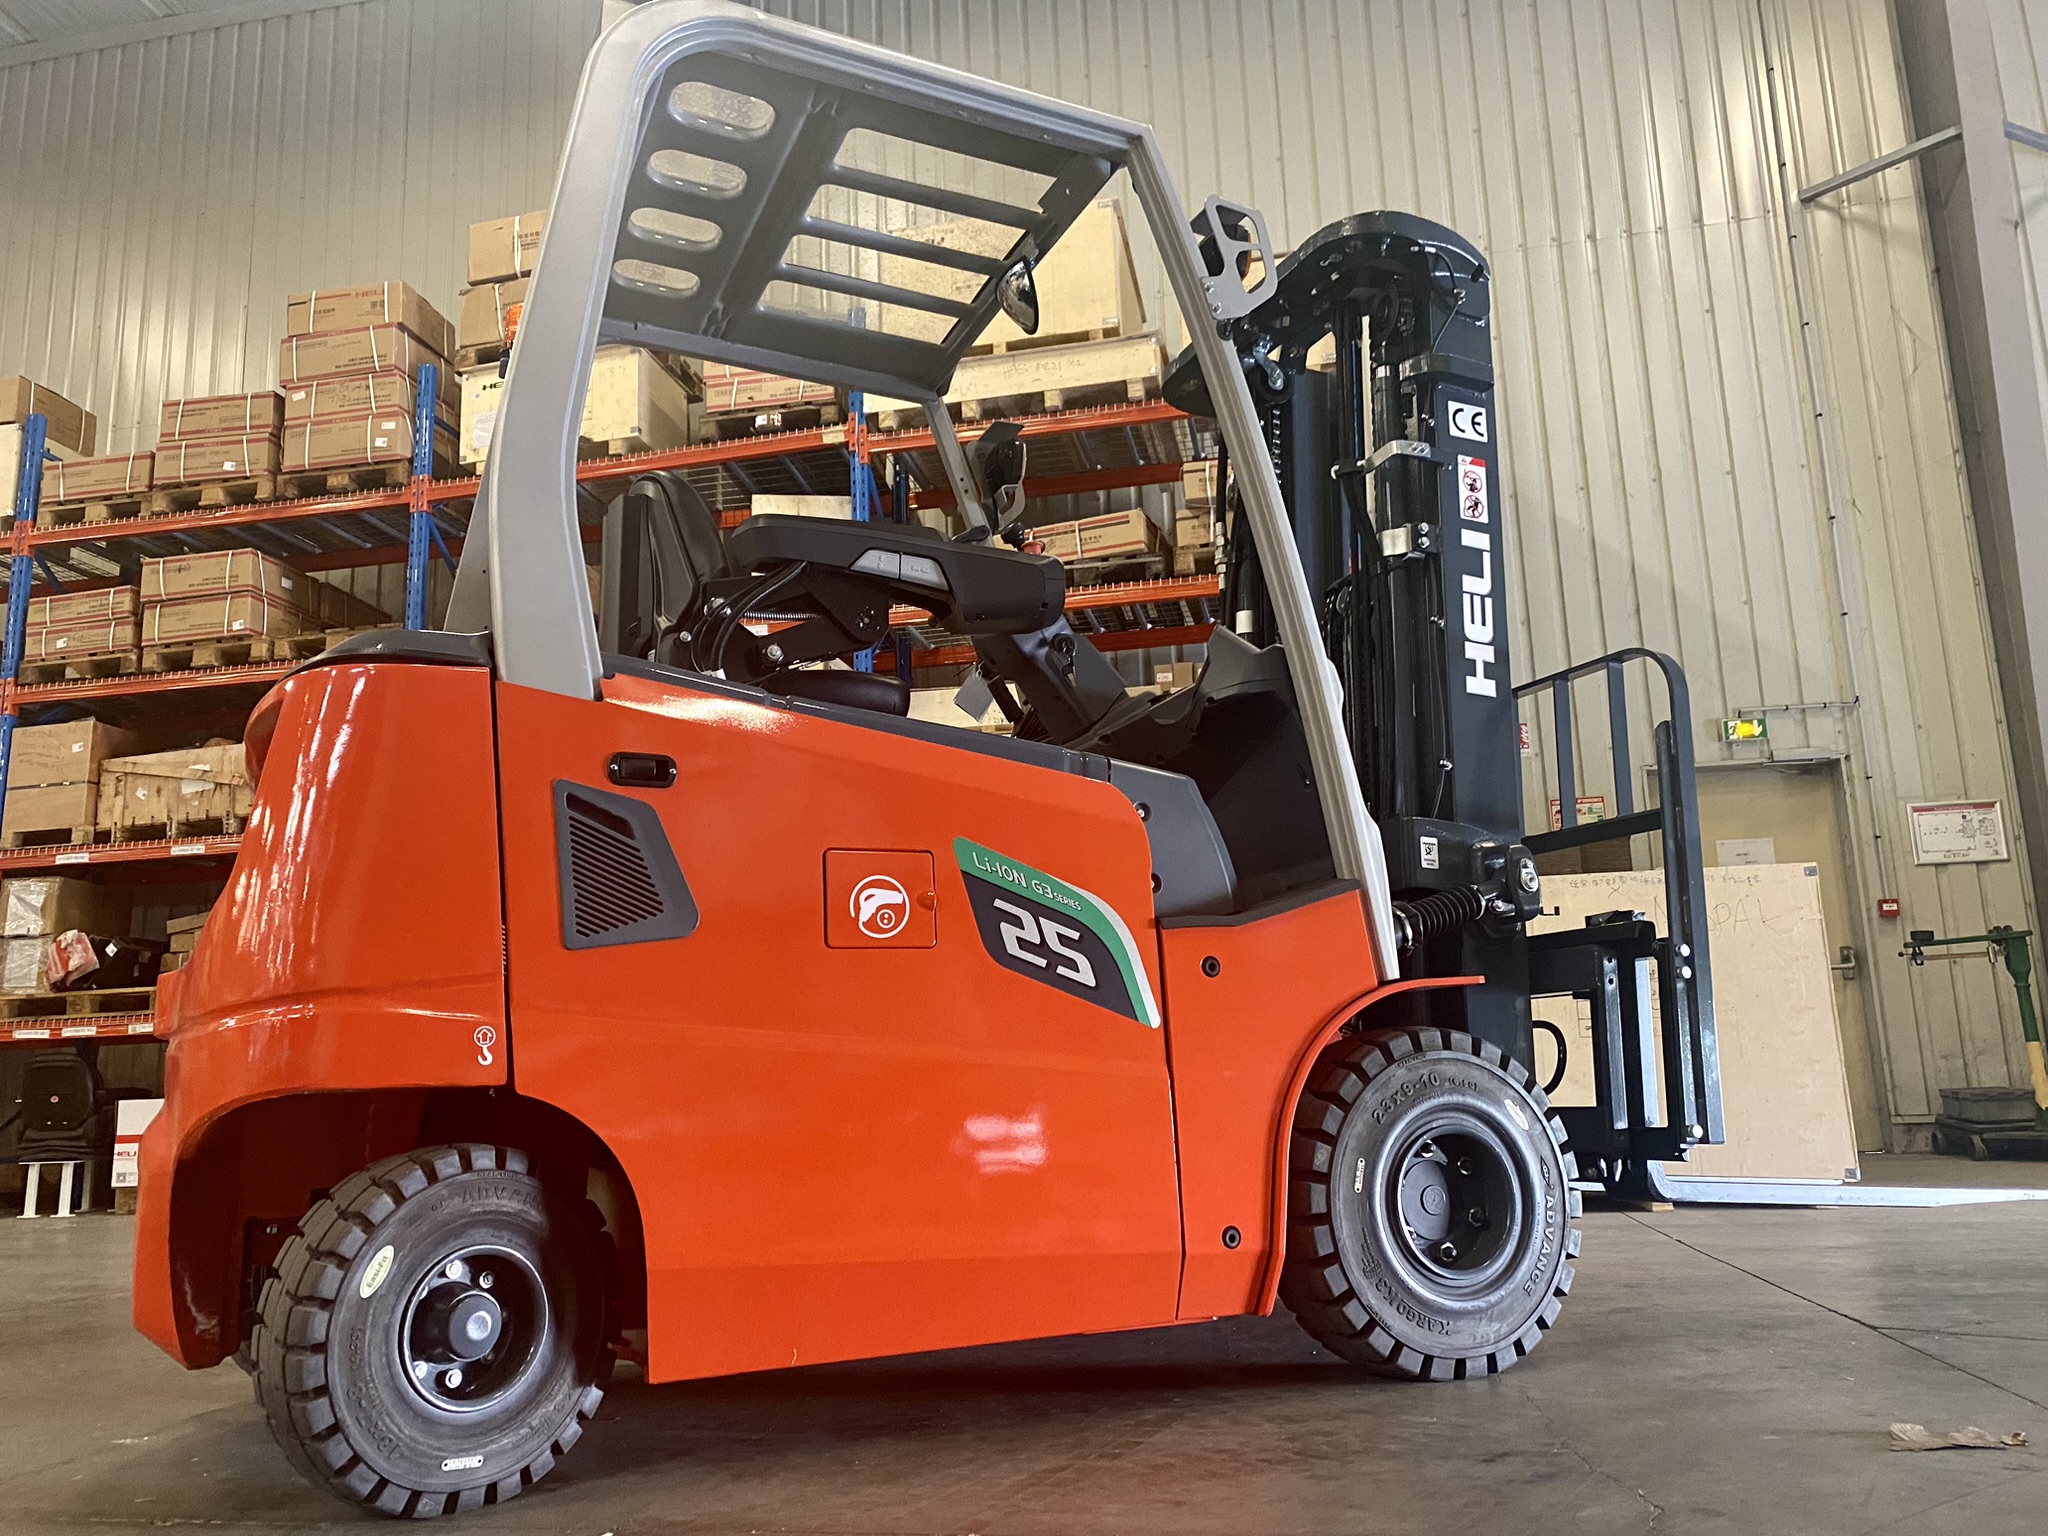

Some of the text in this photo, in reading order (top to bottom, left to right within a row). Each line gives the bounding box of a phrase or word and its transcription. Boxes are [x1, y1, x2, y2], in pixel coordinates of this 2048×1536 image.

[482, 381, 504, 391] HE
[1460, 528, 1498, 698] HELI
[1031, 878, 1054, 899] G3
[1053, 892, 1082, 911] SERIES
[993, 898, 1097, 988] 25
[1522, 1194, 1557, 1297] ADVANCE
[366, 1255, 389, 1288] Easi-Fit
[1396, 1298, 1453, 1337] KARGO
